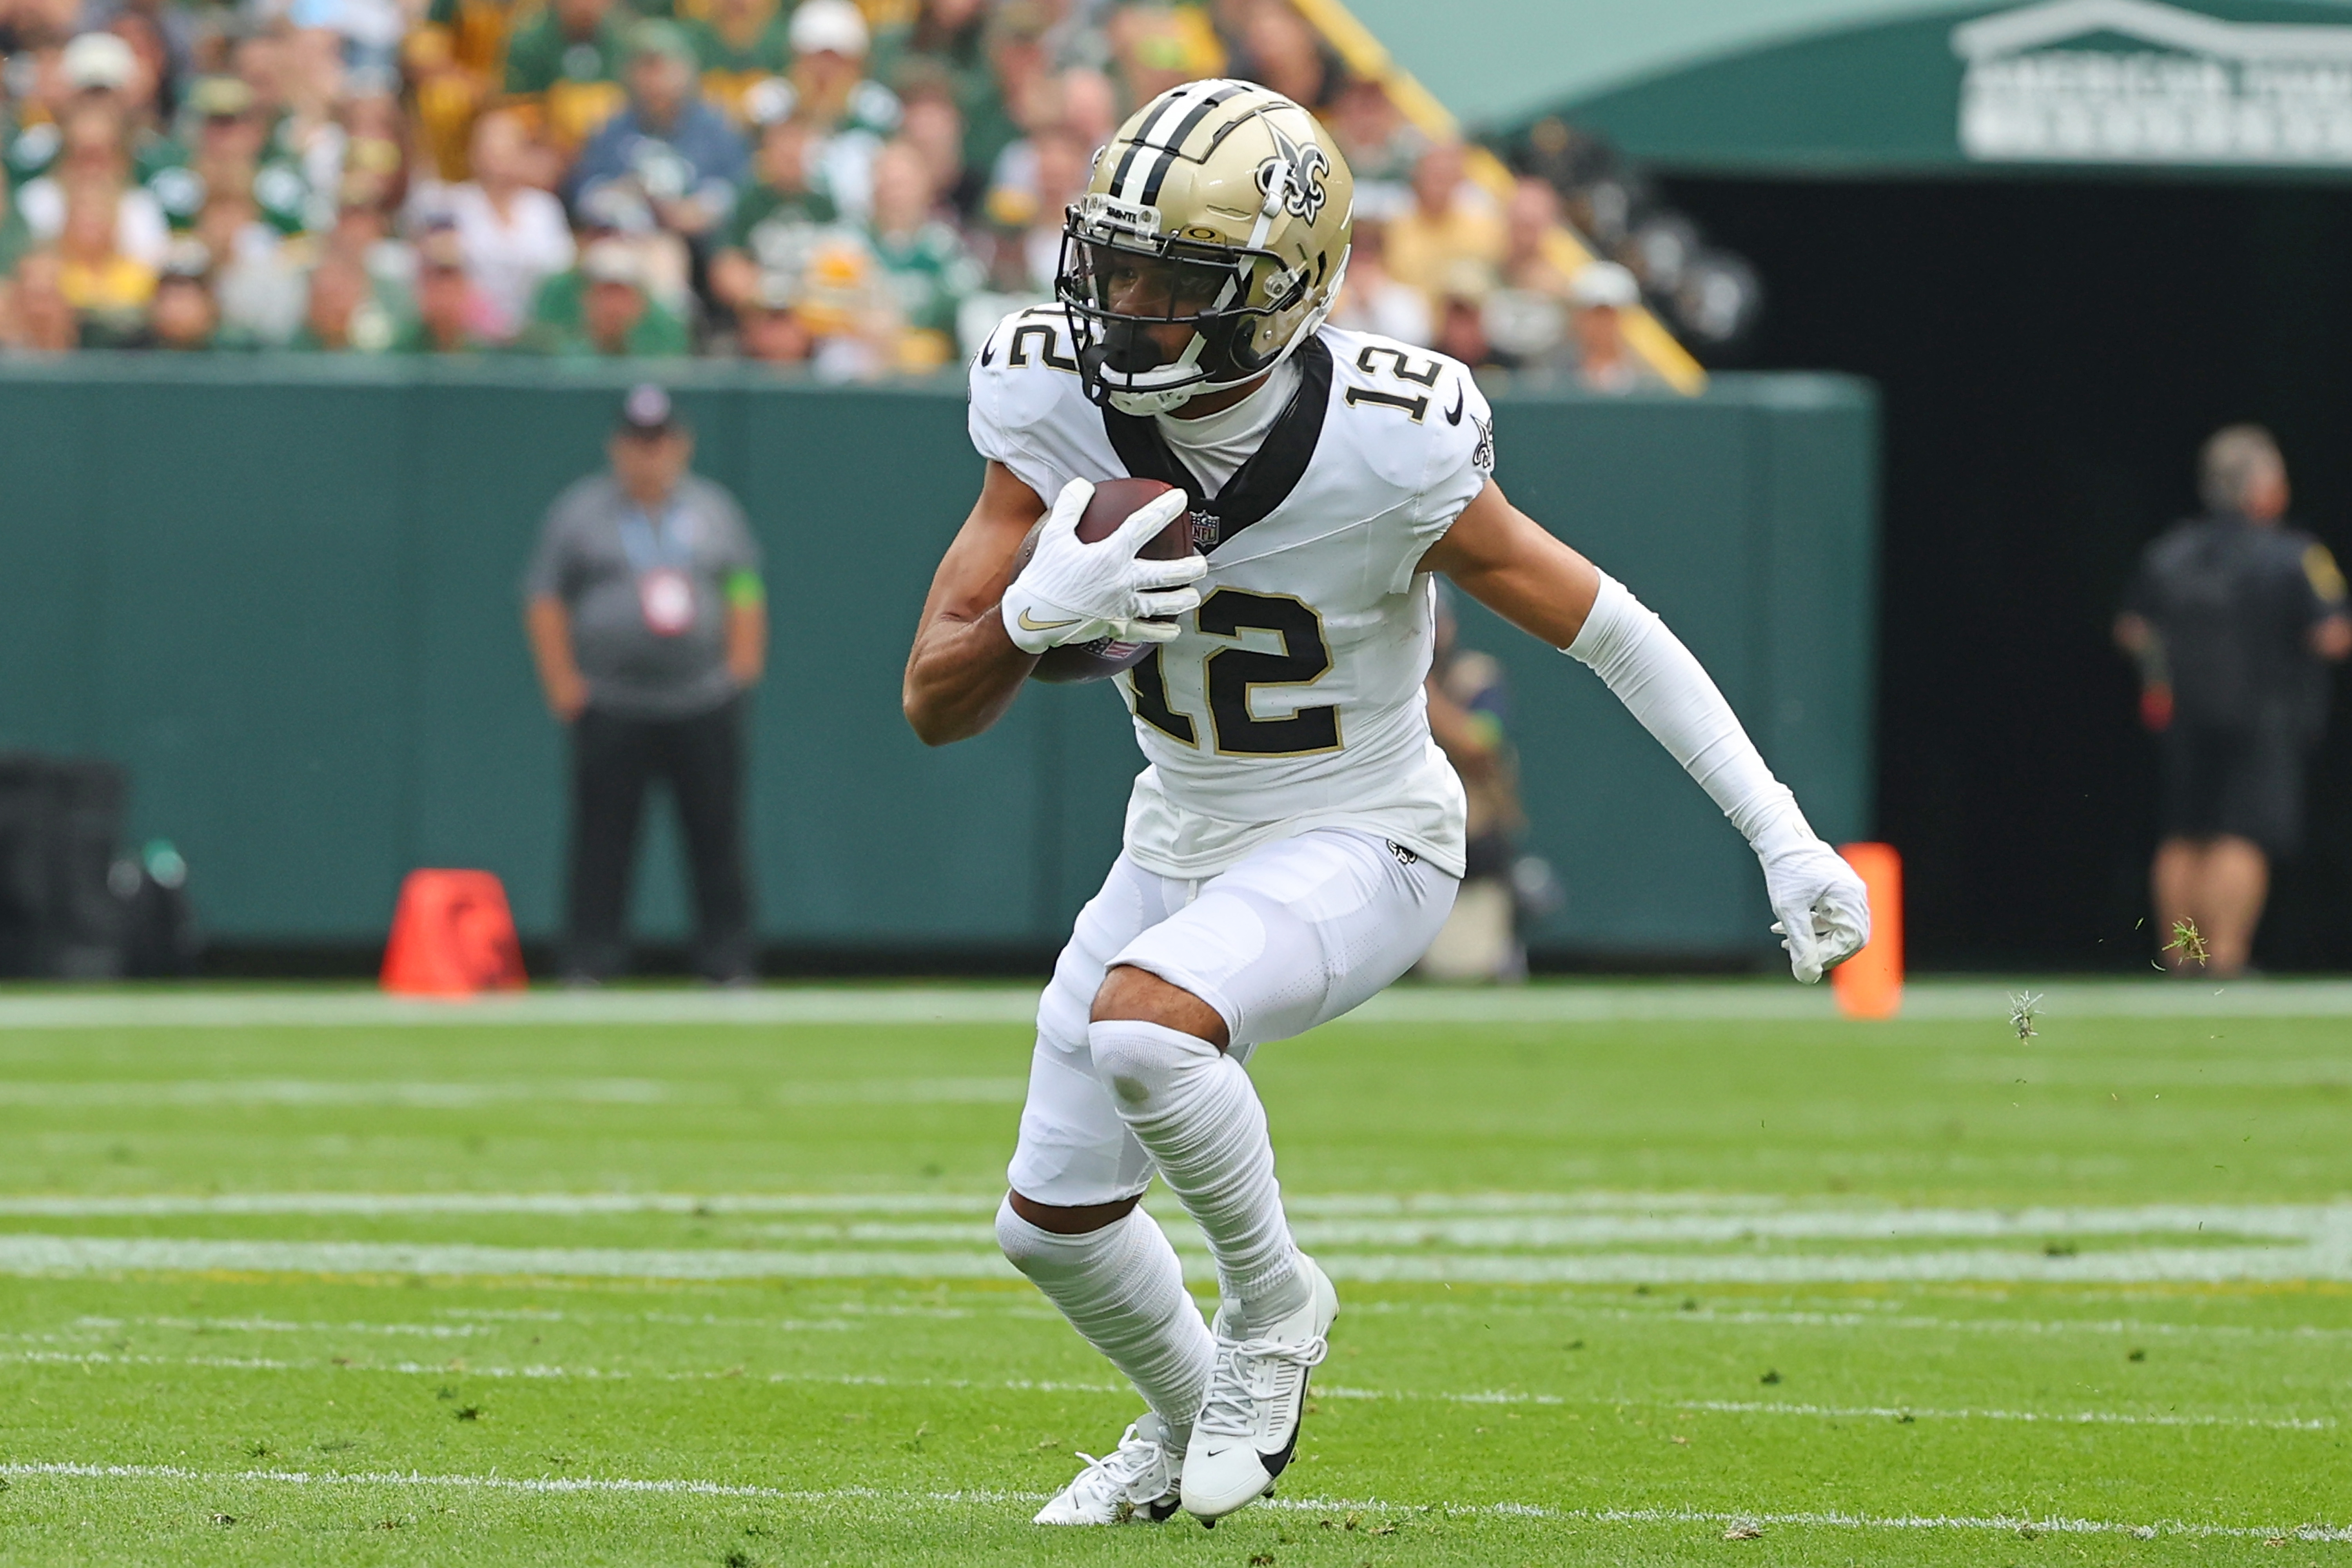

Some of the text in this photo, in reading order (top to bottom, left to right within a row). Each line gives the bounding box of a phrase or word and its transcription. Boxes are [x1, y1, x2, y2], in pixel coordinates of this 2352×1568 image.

[1342, 346, 1444, 426] 12
[1192, 526, 1216, 542] NFL
[1127, 586, 1345, 758] 12
